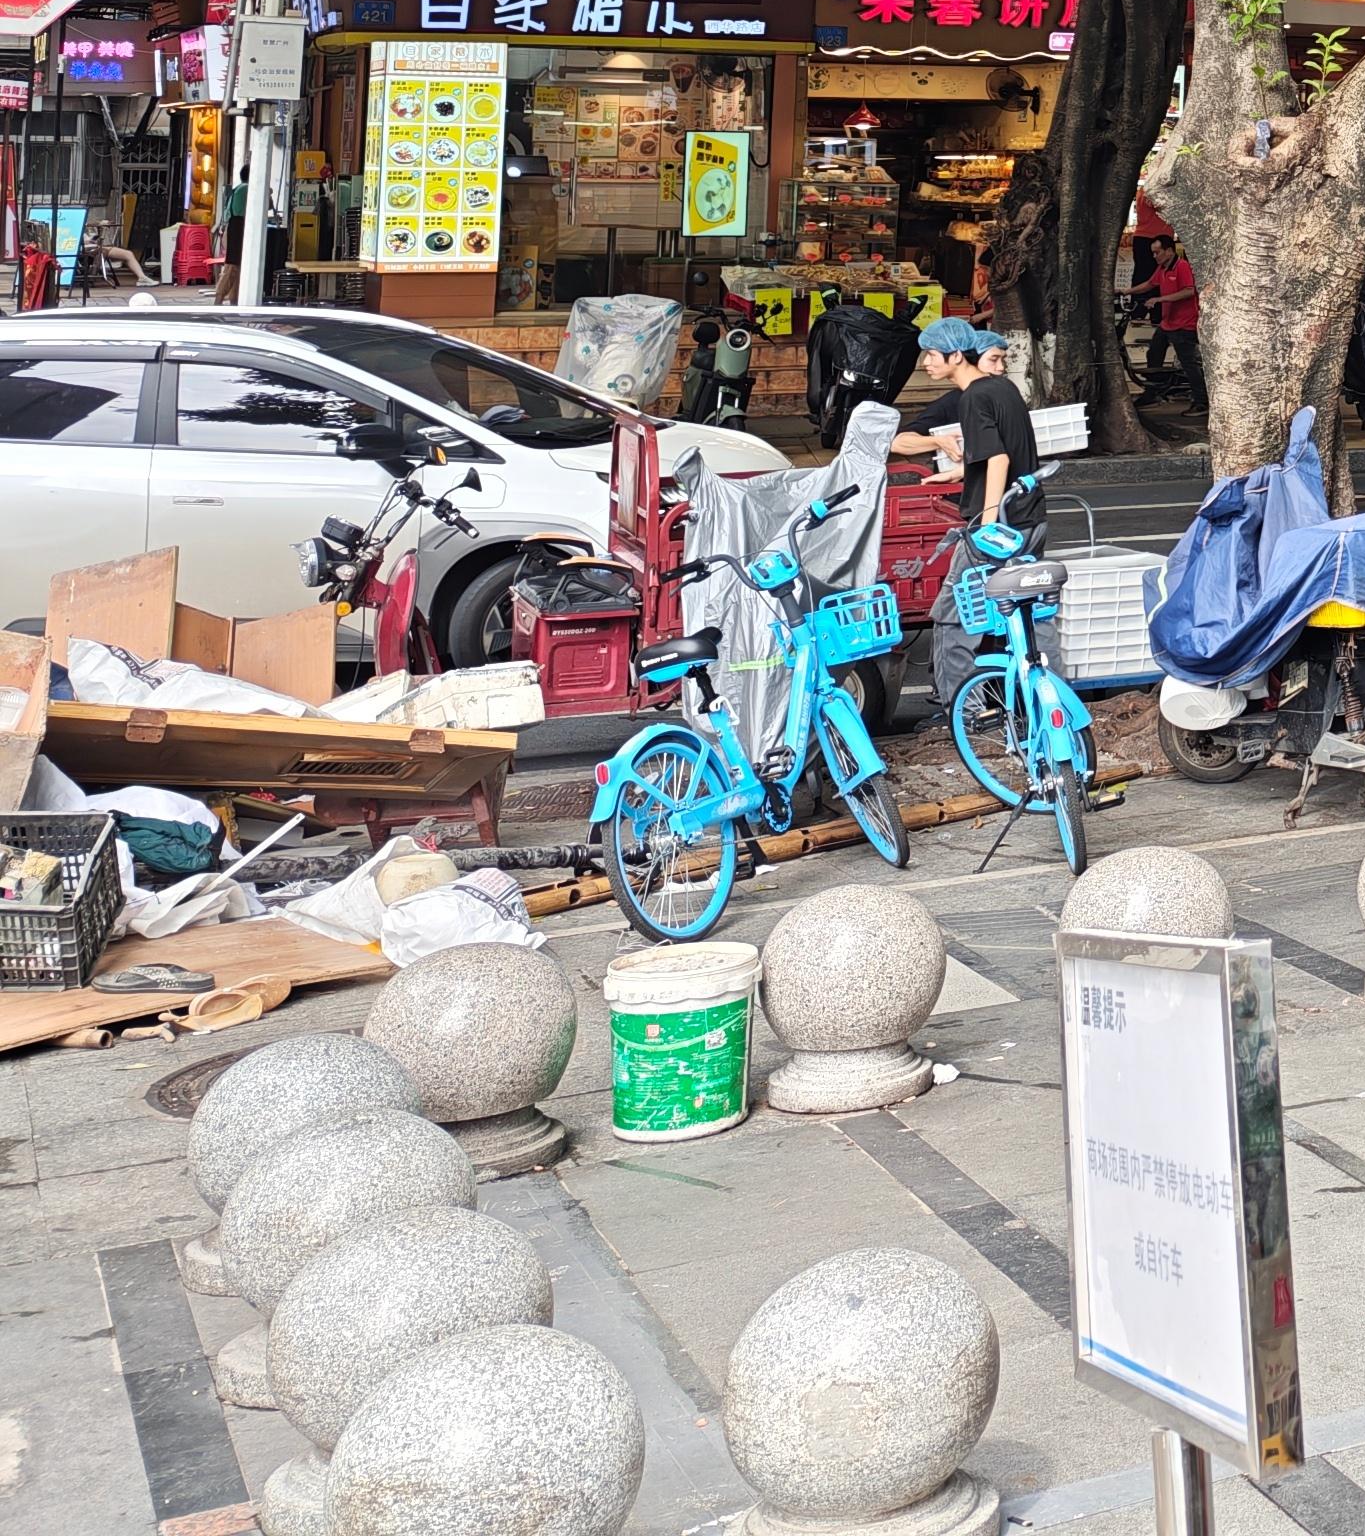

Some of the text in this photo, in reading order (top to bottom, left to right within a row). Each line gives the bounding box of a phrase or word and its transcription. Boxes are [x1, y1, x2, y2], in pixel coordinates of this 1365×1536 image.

[361, 11, 387, 23] 421
[1080, 986, 1127, 1033] 温馨提示
[1086, 1136, 1233, 1218] 商场范围内严禁停放电动车
[1133, 1231, 1183, 1287] 或自行车
